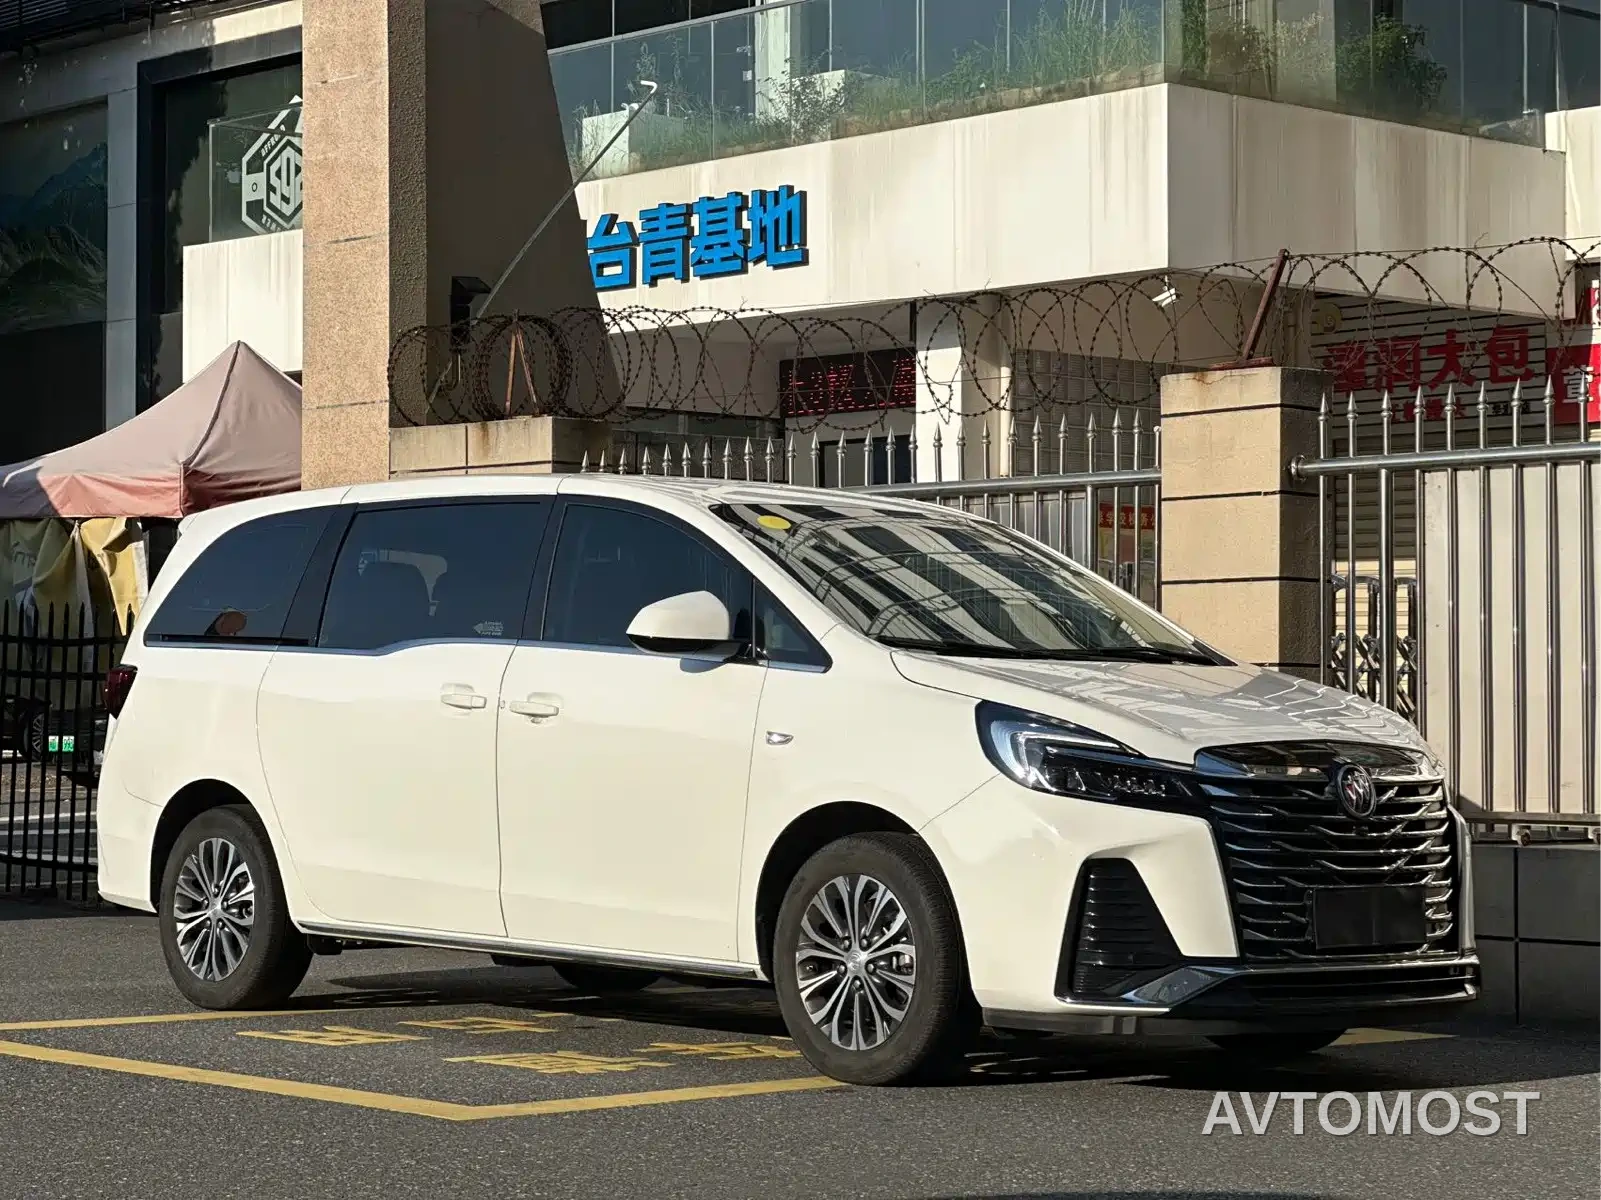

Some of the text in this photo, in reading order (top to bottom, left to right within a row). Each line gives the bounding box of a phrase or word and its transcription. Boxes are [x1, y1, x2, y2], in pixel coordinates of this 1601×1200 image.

[586, 184, 808, 291] 台青基地
[233, 1012, 572, 1047] 占用
[443, 1038, 803, 1077] 车道
